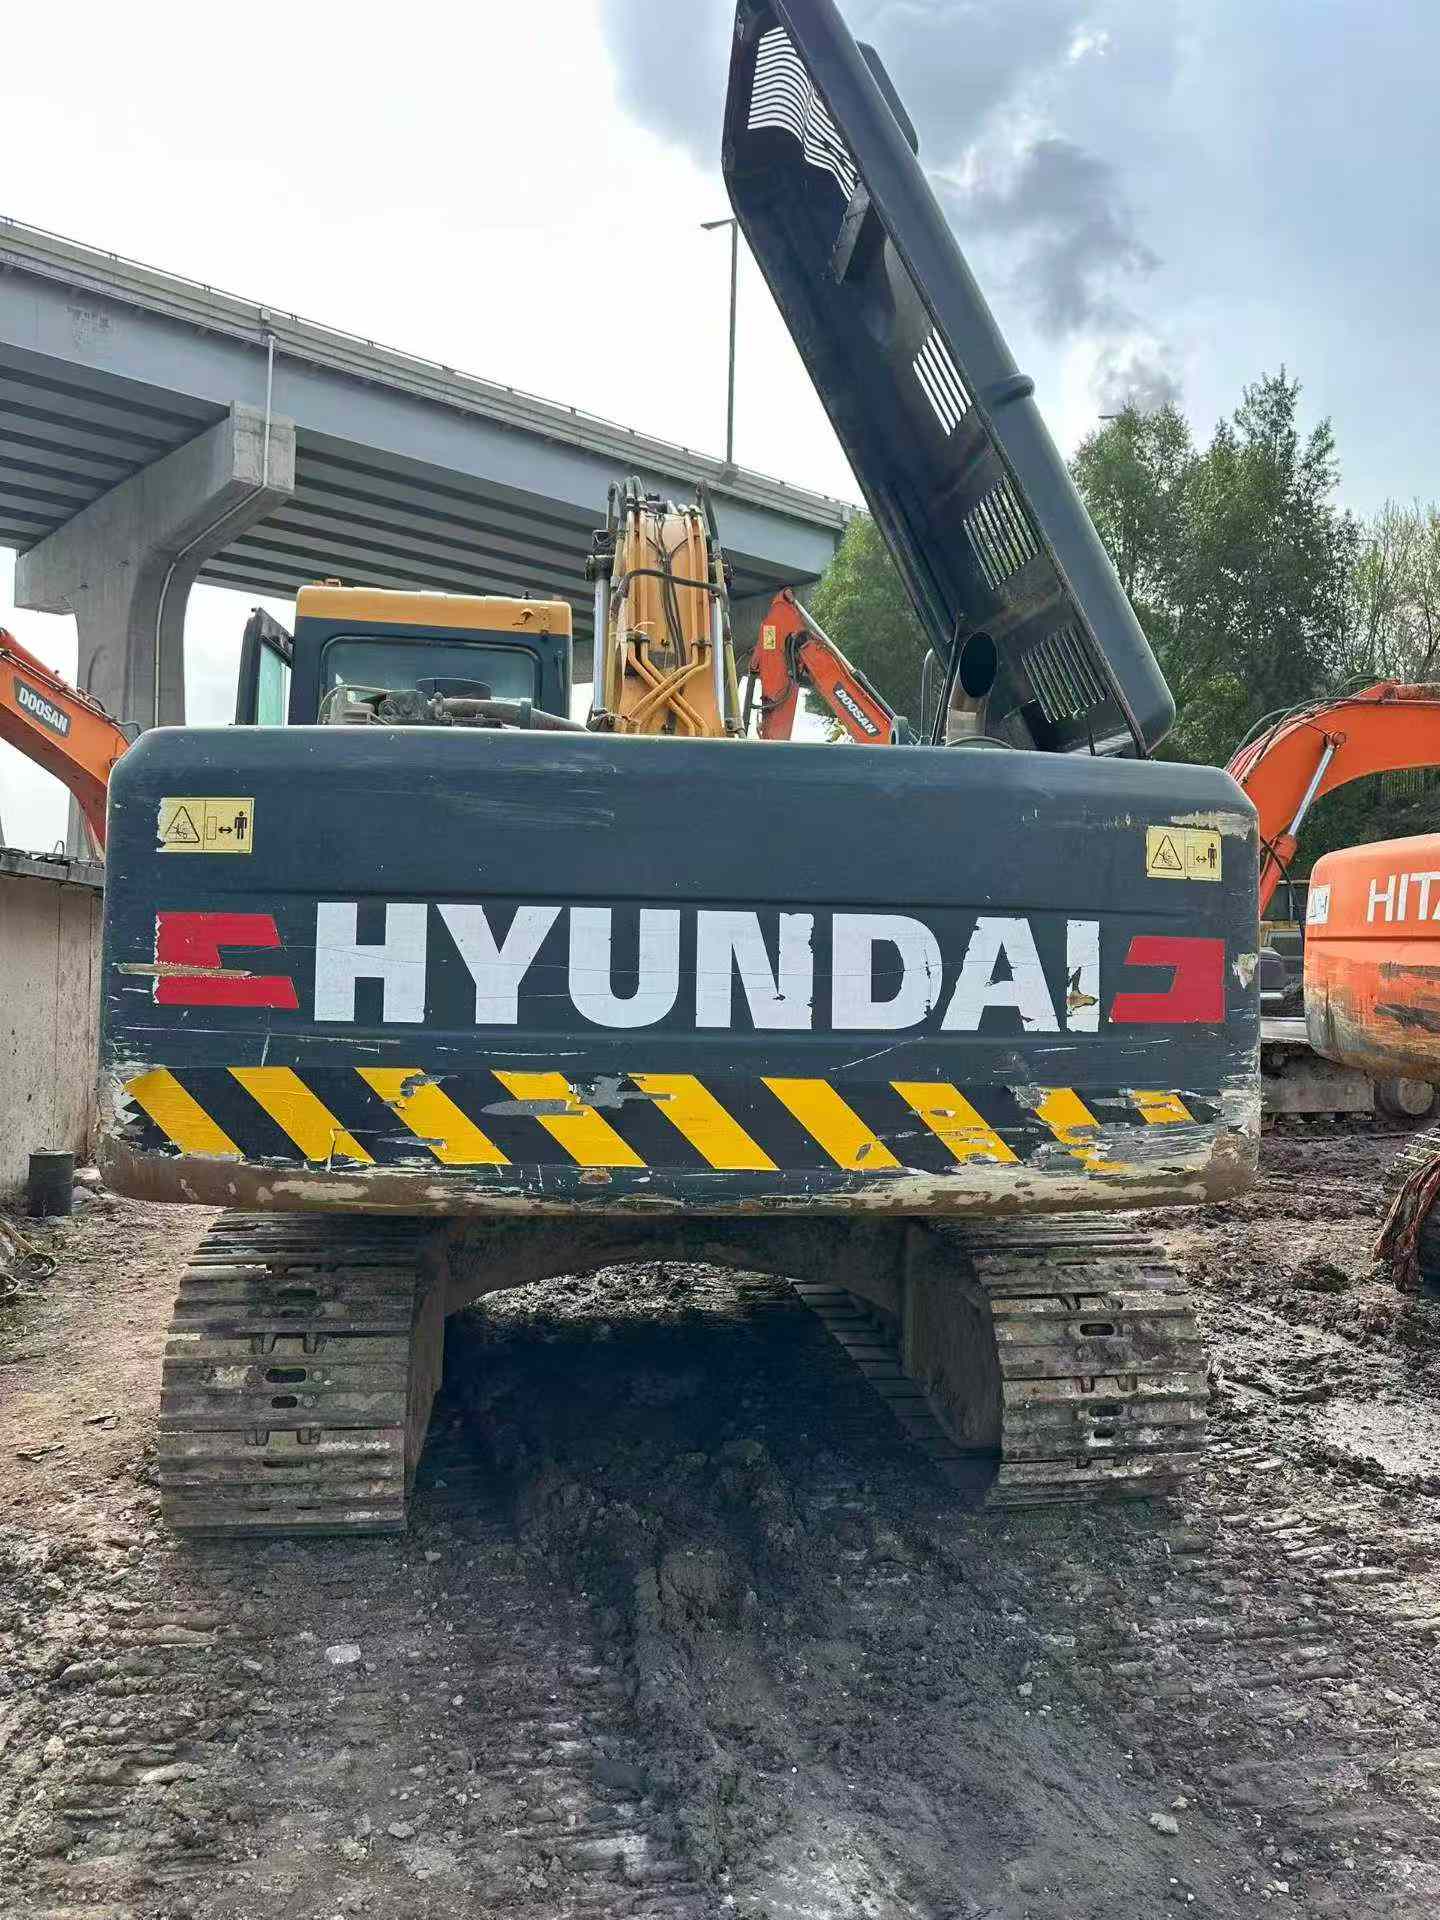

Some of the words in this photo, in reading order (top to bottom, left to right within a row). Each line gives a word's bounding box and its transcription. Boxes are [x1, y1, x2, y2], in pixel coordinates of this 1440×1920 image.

[18, 686, 68, 734] DOOSAN
[835, 688, 877, 734] DOOSAN
[1366, 871, 1440, 922] HIT
[314, 902, 1101, 1034] HYUNDAI
